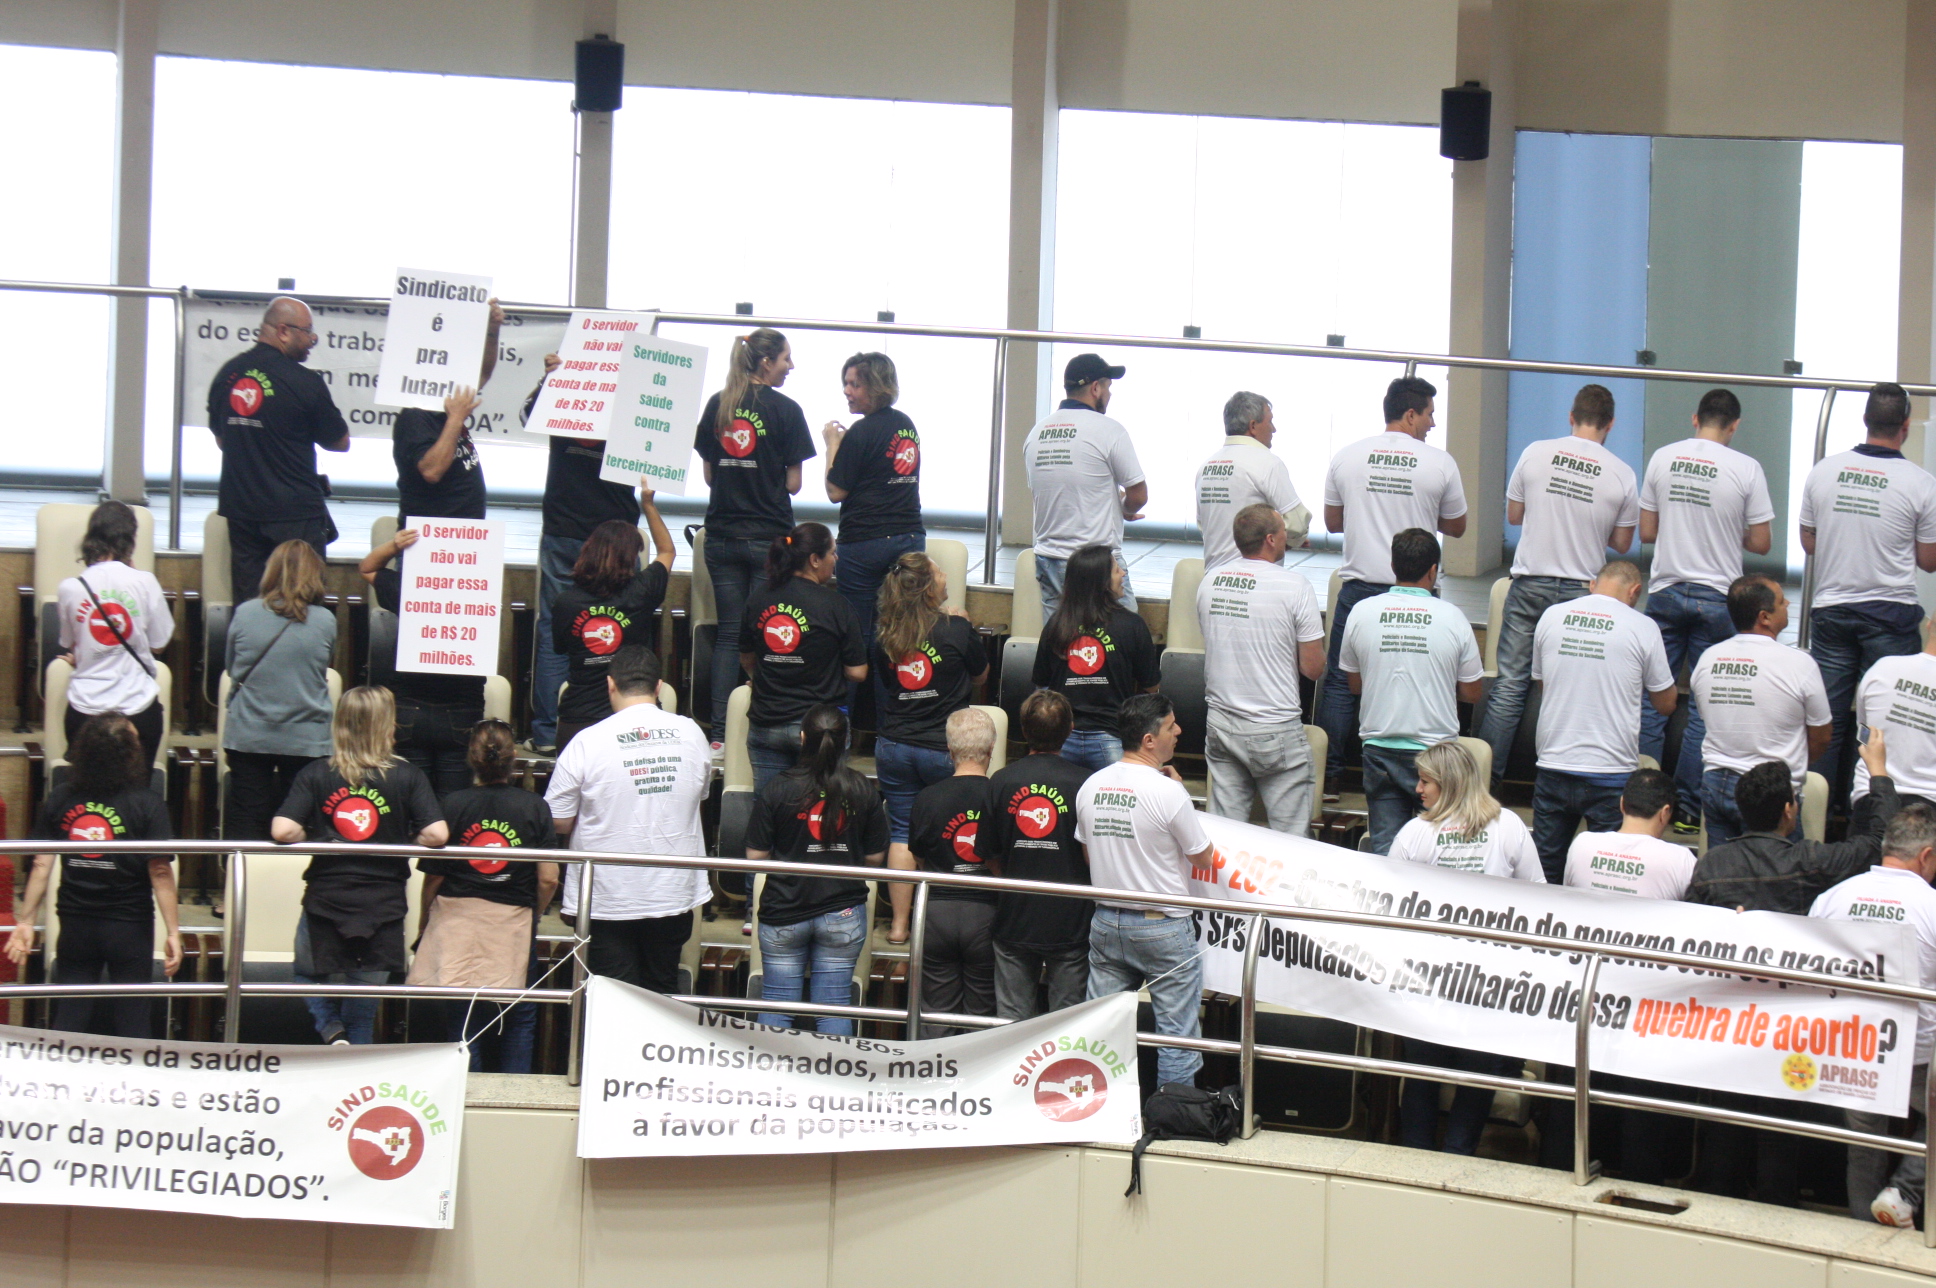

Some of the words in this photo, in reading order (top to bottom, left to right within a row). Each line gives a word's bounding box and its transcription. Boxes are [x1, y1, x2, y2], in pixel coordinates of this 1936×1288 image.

[397, 276, 488, 303] Sindicato
[198, 319, 228, 341] do
[431, 313, 443, 332] é
[582, 318, 591, 330] O
[592, 320, 638, 331] servidor
[583, 339, 604, 351] não
[606, 341, 623, 352] vai
[416, 348, 448, 365] pra
[634, 345, 693, 369] Servidores
[564, 360, 598, 371] pagar
[599, 362, 620, 372] ess
[401, 376, 454, 397] lutar!
[548, 378, 580, 390] conta
[582, 380, 597, 391] de
[599, 382, 616, 393] ma
[653, 372, 666, 386] da
[555, 398, 569, 409] de
[572, 400, 586, 411] R$
[589, 401, 604, 412] 20
[640, 394, 672, 410] saúde
[546, 418, 594, 432] milhões.
[635, 416, 670, 432] contra
[1038, 428, 1077, 440] APRASC
[645, 441, 652, 452] a
[606, 454, 685, 482] terceirização!!
[1202, 464, 1234, 476] APRASC
[1367, 454, 1418, 468] APRASC
[1551, 455, 1601, 476] APRASC
[1670, 461, 1718, 478] APRASC
[1837, 471, 1888, 489] APRASC
[423, 524, 430, 537] O
[434, 526, 488, 540] servidor
[430, 550, 454, 564] não
[458, 552, 477, 565] vai
[416, 576, 454, 590] pagar
[457, 579, 488, 590] essa
[1212, 576, 1256, 590] APRASC
[76, 589, 140, 623] SINSAÚDE
[405, 601, 441, 613] conta
[445, 601, 461, 614] de
[464, 603, 496, 616] mais
[572, 606, 631, 636] SINDSAÚDE
[757, 603, 809, 633] SINDSAÚDE
[1379, 612, 1432, 625] APRASC
[1563, 614, 1614, 631] APRASC
[421, 625, 437, 639] de
[441, 626, 457, 641] R$
[460, 627, 476, 640] 20
[419, 651, 475, 666] milhões.
[1711, 662, 1758, 677] APRASC
[321, 785, 390, 815] SINDSAÚDE
[1007, 783, 1068, 814] SINDSAÚDE
[1094, 793, 1136, 808] APRASC
[60, 802, 126, 835] SINDSAÚDE
[1590, 856, 1645, 876] APRASC
[1848, 903, 1905, 921] APRASC
[1294, 869, 1394, 915] Qbra
[1436, 906, 1528, 950] acordo
[1532, 912, 1567, 956] do
[1569, 924, 1675, 971] governo
[1677, 938, 1737, 979] com
[1259, 919, 1387, 984] Deputados
[1389, 958, 1546, 1016] partilharão
[1632, 997, 1732, 1042] quebra
[1733, 1003, 1770, 1048] de
[1773, 1014, 1898, 1063] acordo?
[0, 1038, 132, 1064] rvidores
[142, 1045, 179, 1068] da
[190, 1048, 280, 1073] saúde
[642, 1042, 876, 1082] comissionados,
[888, 1054, 958, 1078] mais
[1013, 1036, 1127, 1087] SINDSAÚDE
[1820, 1063, 1878, 1089] APRASC
[172, 1091, 186, 1109] e
[199, 1090, 280, 1114] estão
[604, 1077, 797, 1108] profissionais
[808, 1091, 992, 1116] qualificados
[328, 1082, 447, 1136] SINDSAÚDE
[660, 1113, 739, 1137] favor
[750, 1114, 785, 1136] da
[68, 1119, 104, 1145] da
[116, 1127, 284, 1162] população,
